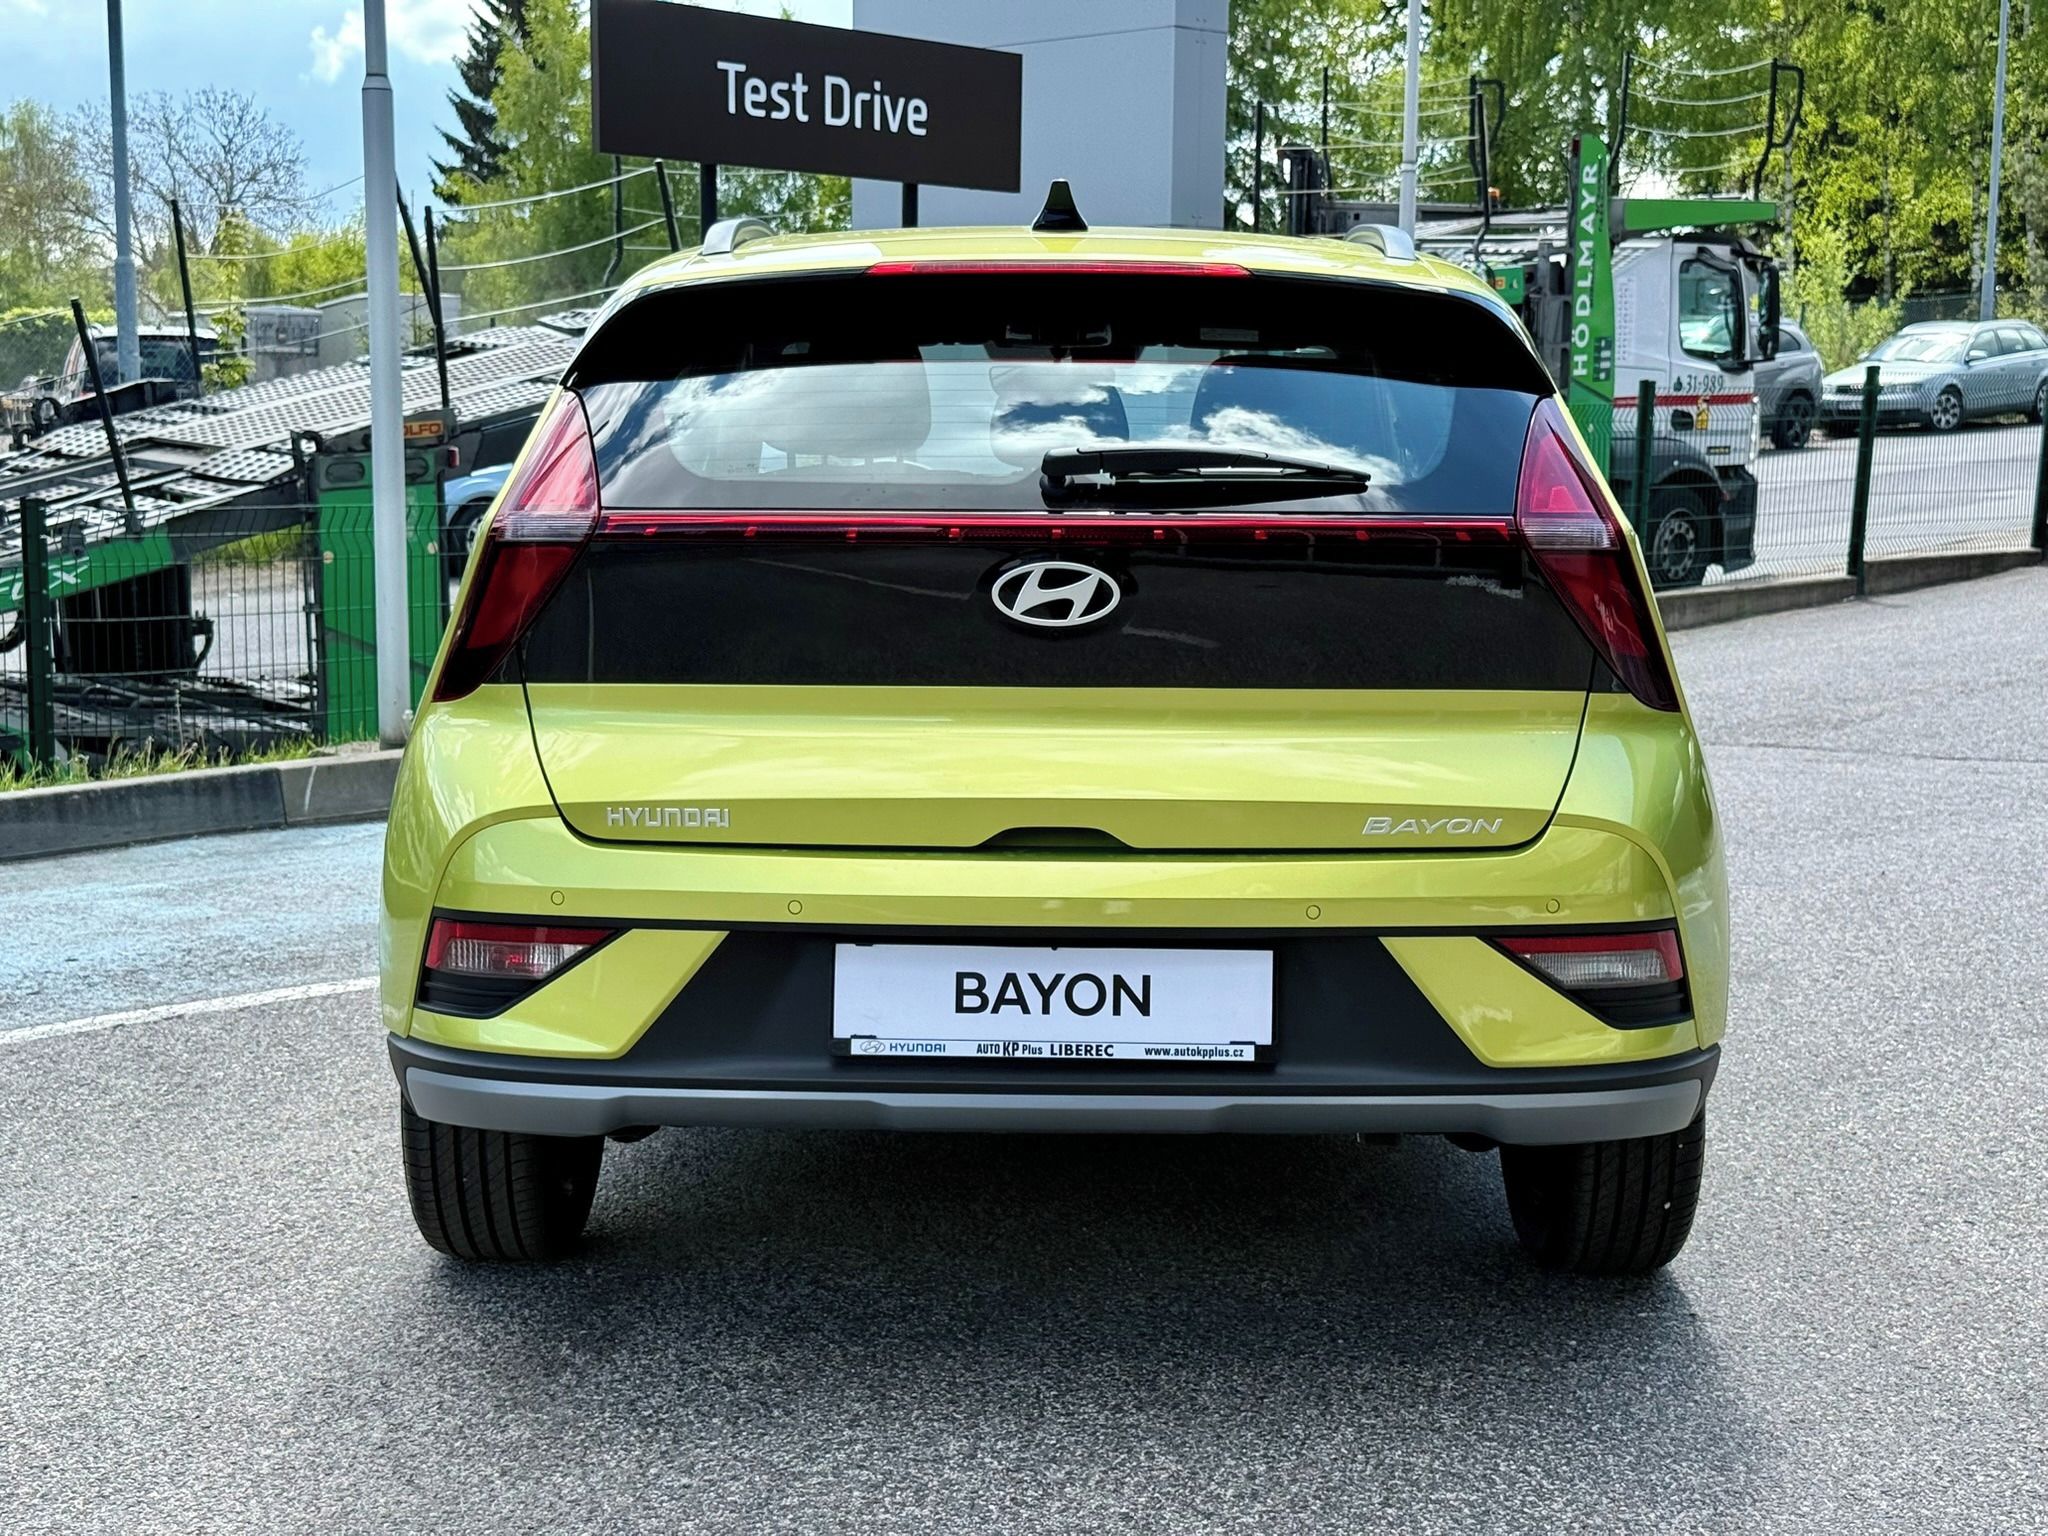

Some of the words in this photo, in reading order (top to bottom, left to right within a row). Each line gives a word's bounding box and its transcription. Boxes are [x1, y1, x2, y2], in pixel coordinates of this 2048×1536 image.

[716, 60, 810, 123] Test
[823, 74, 929, 137] Drive
[1571, 163, 1598, 377] HÖDLMAYR
[606, 807, 730, 828] HYUNDAI
[1361, 816, 1503, 836] BAYON
[954, 971, 1152, 1017] BAYON
[889, 1042, 946, 1053] HYUNDAI
[976, 1043, 1000, 1055] AUTO
[1002, 1041, 1020, 1057] KP
[1022, 1044, 1043, 1056] Plus
[1050, 1044, 1115, 1058] LIBEREC
[1144, 1046, 1245, 1060] www.autokpplus.cz
